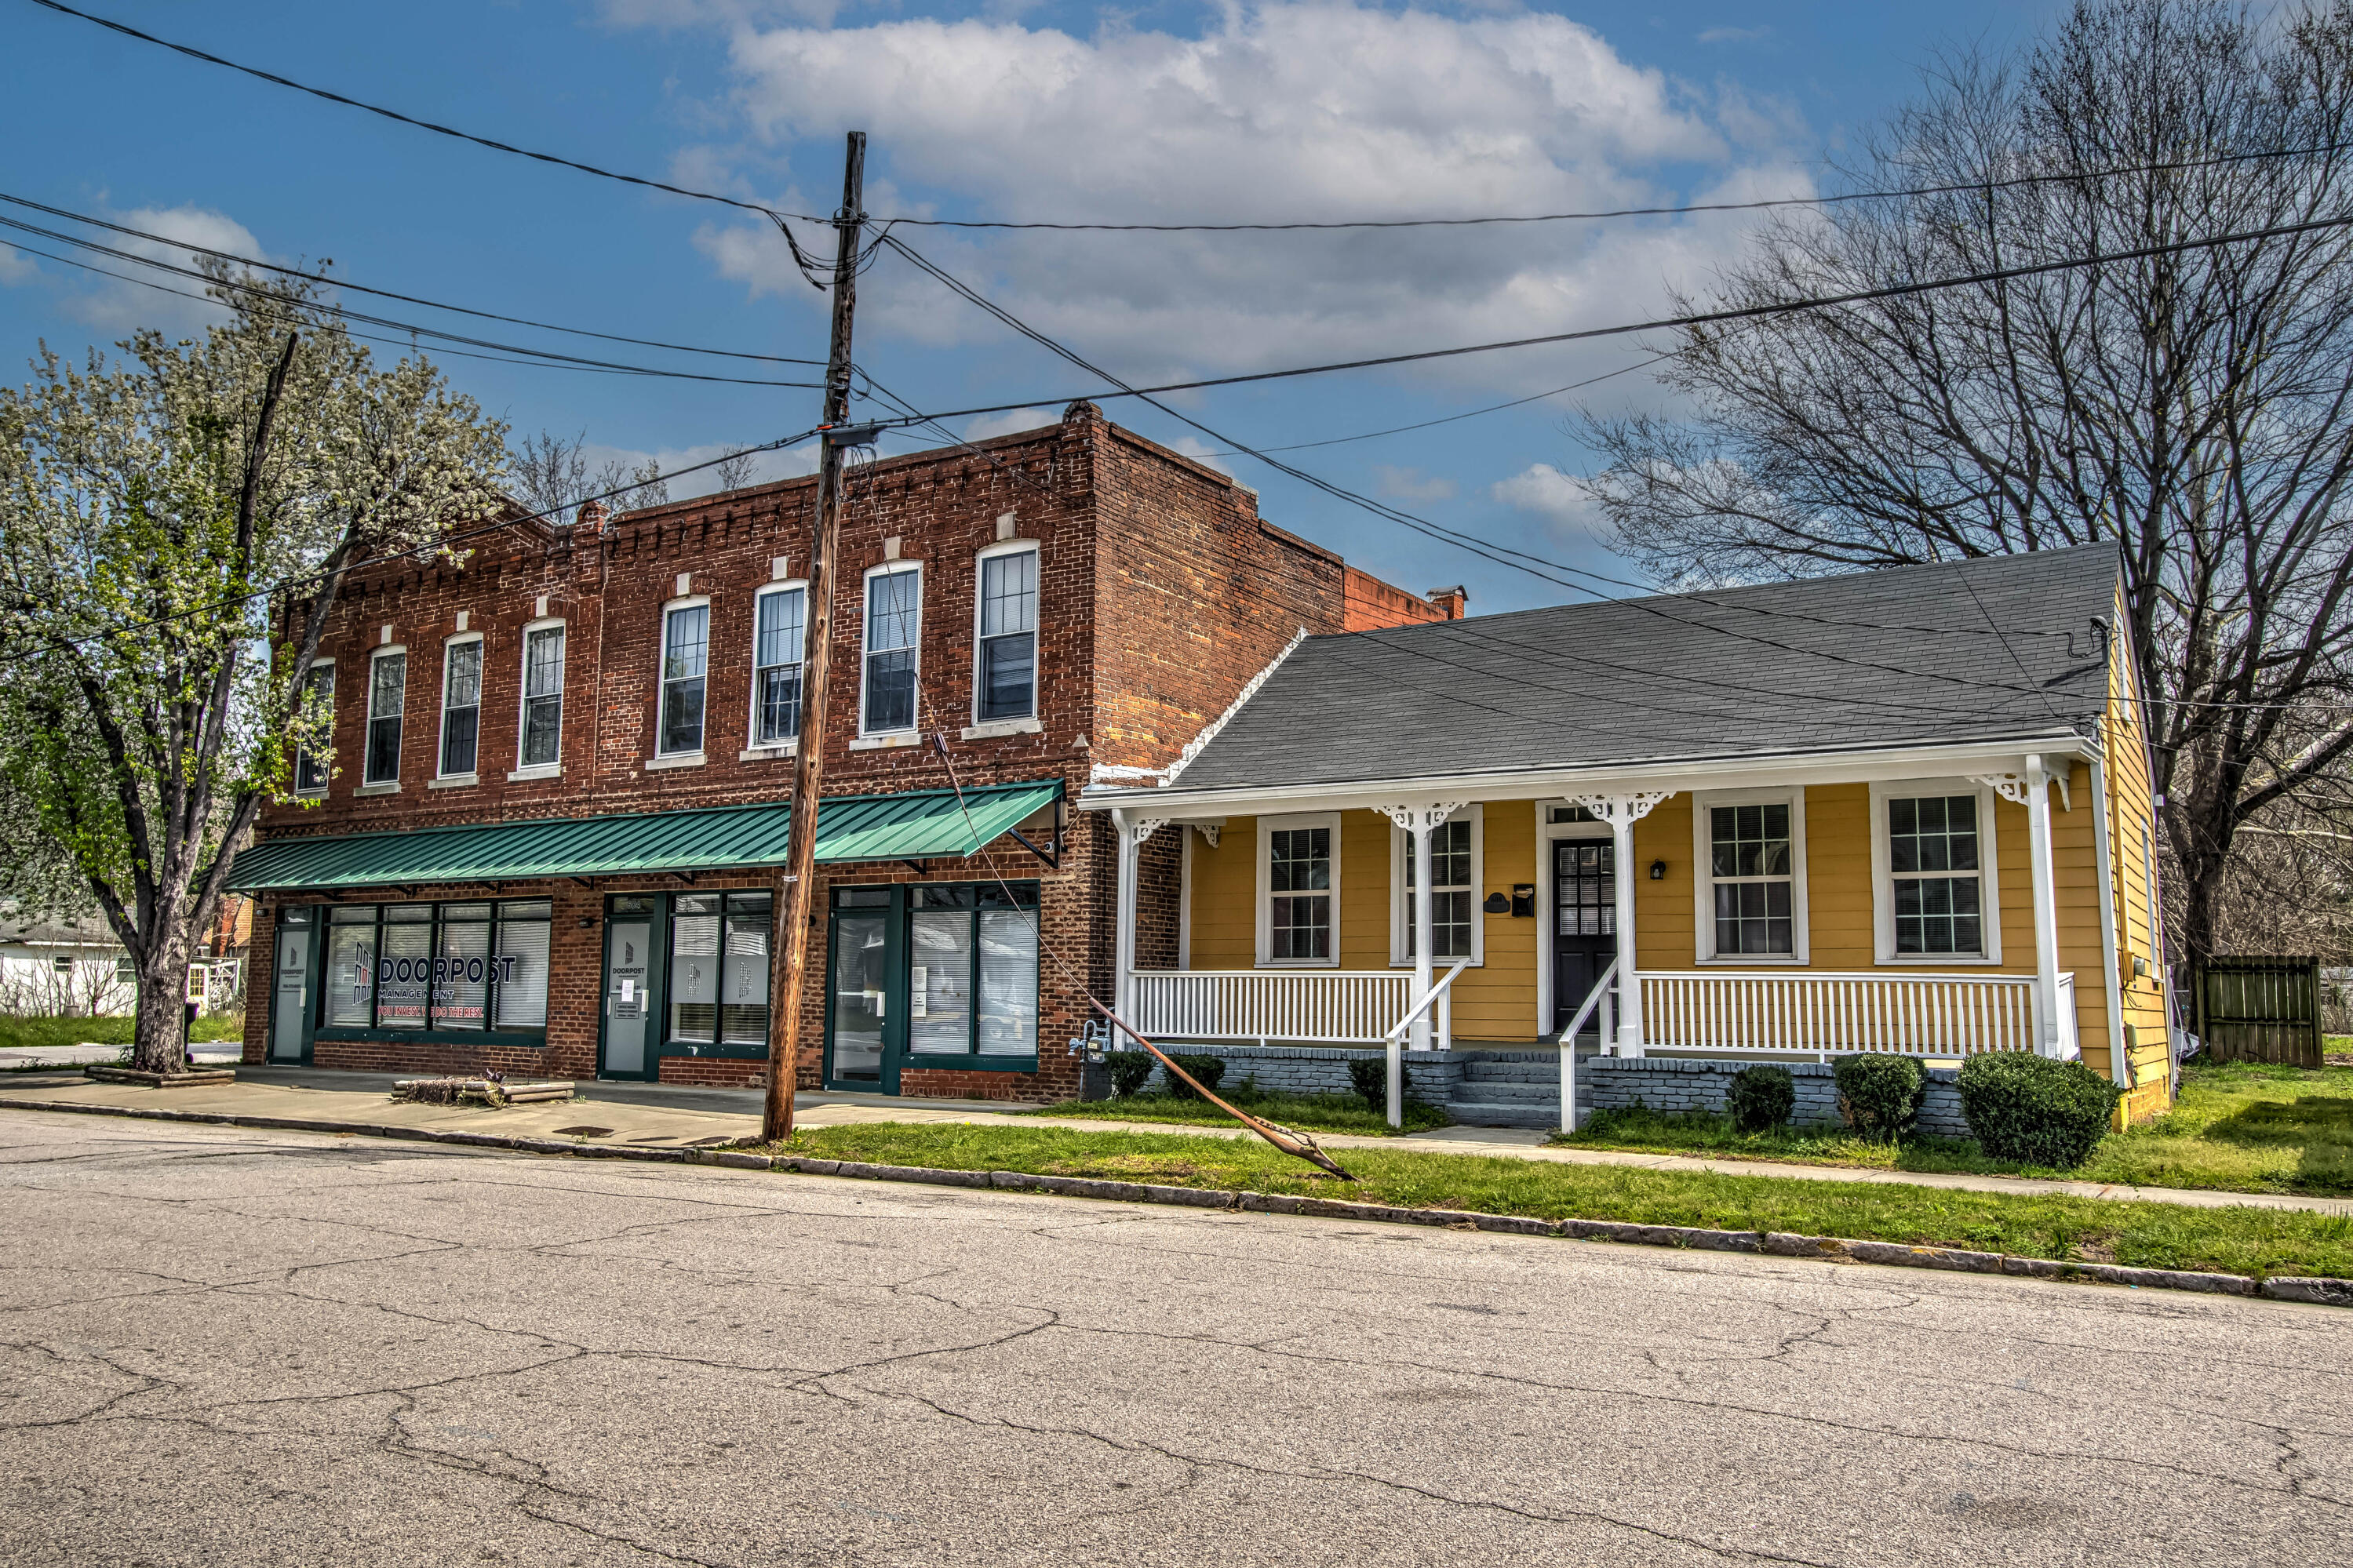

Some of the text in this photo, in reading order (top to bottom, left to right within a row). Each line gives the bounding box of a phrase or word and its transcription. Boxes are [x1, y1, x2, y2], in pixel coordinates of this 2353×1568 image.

[379, 956, 517, 984] DOORPOST
[377, 1006, 393, 1017] YOU
[394, 1006, 421, 1017] INVEST.
[435, 1006, 447, 1017] DO
[449, 1007, 463, 1018] THE
[464, 1007, 484, 1018] REST.
